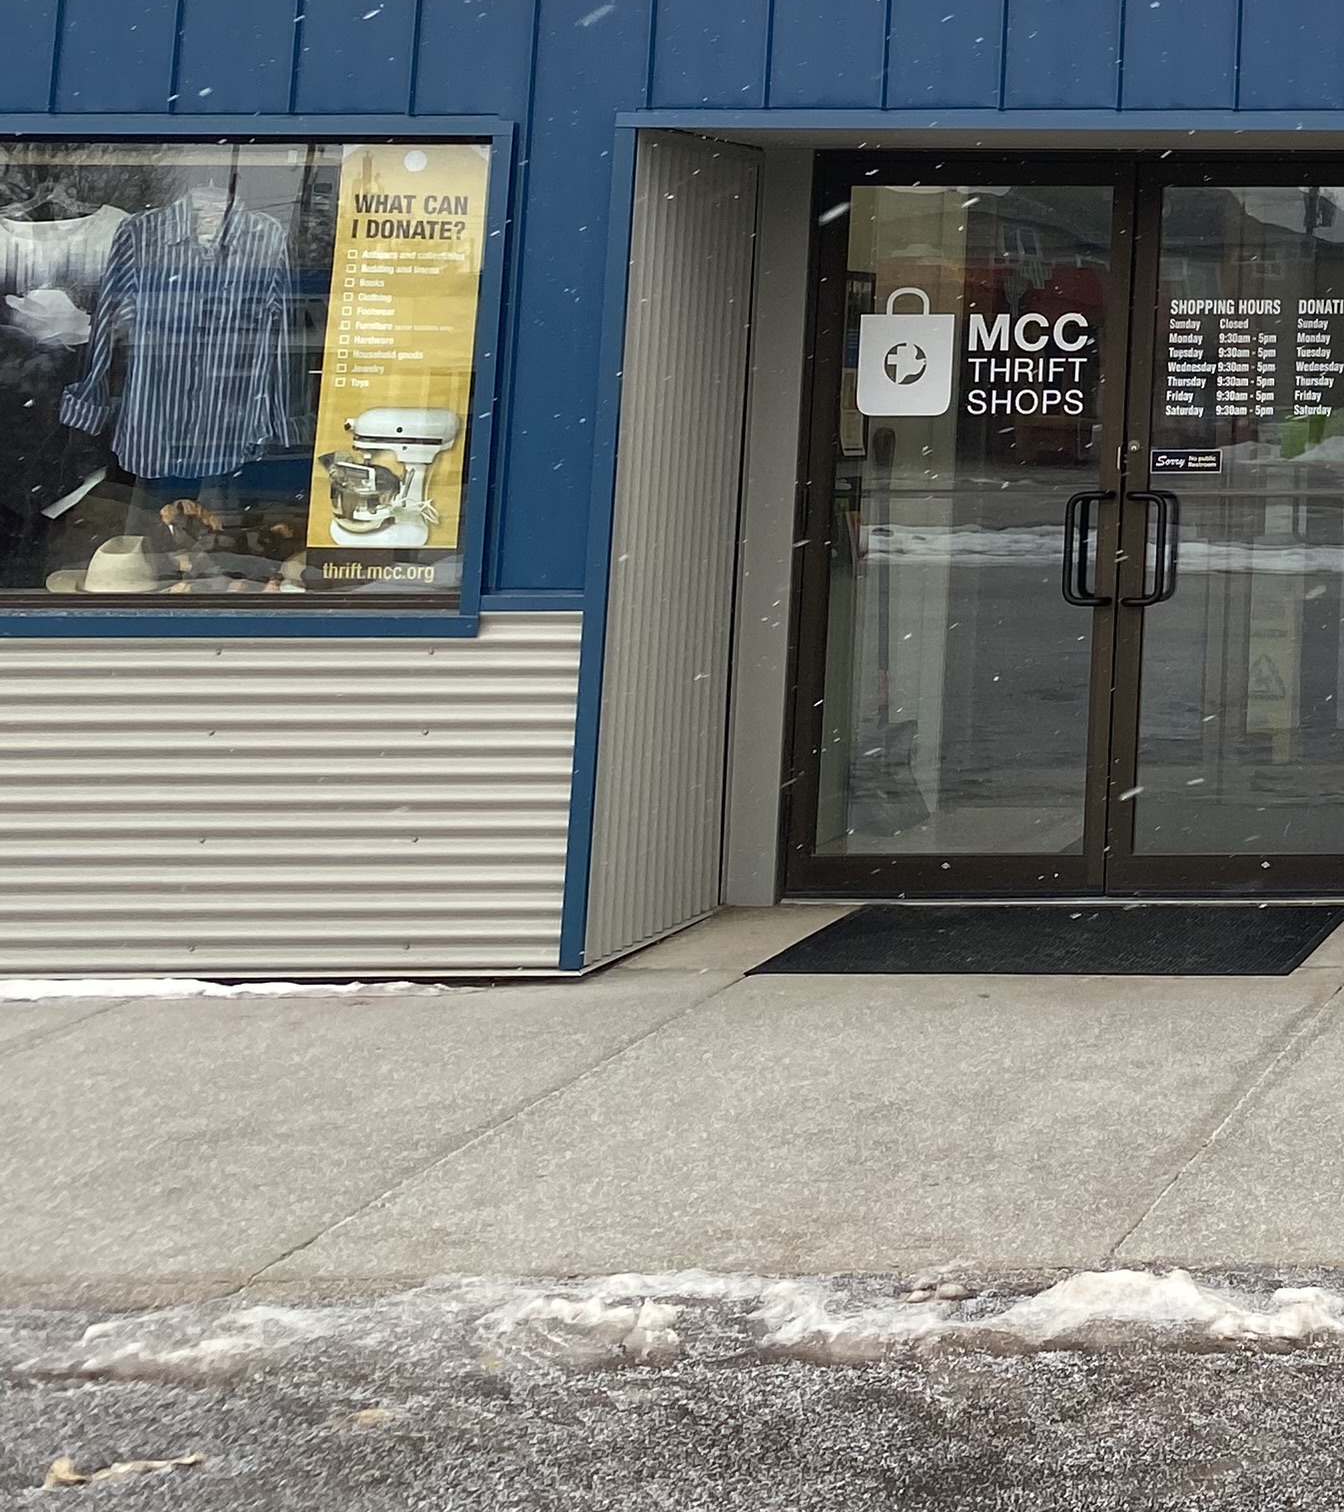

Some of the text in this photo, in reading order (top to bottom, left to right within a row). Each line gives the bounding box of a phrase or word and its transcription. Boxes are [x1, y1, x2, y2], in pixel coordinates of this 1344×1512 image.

[355, 194, 469, 215] WHAT CAN
[351, 219, 466, 240] I DONATE?
[1170, 299, 1281, 315] SHOPPING HOURS
[1170, 319, 1248, 331] Sunday Closed
[1297, 318, 1329, 330] Sunday
[968, 313, 1089, 352] MCC
[1169, 333, 1203, 345] Monday
[1219, 333, 1250, 343] 9:30am
[1258, 333, 1276, 345] 5pm
[1297, 333, 1330, 345] Monday
[1169, 348, 1203, 359] Tuesday
[1218, 348, 1249, 357] 9:30am
[1258, 348, 1276, 359] 5pm
[1297, 347, 1331, 359] Tuesday
[968, 358, 1088, 383] THRIFT
[1168, 362, 1216, 374] Wednesday
[1218, 362, 1249, 372] 9:30am
[1257, 362, 1275, 374] 5pm
[1296, 362, 1344, 373] Wednesday
[1167, 376, 1206, 388] Thursday
[1217, 376, 1248, 386] 9:30am
[1256, 376, 1274, 388] 5pm
[1296, 376, 1334, 388] Thursday
[967, 389, 1084, 415] SHOPS
[1166, 391, 1193, 403] Friday
[1216, 391, 1248, 400] 9:30am
[1256, 391, 1274, 402] 5pm
[1295, 391, 1321, 402] Friday
[1166, 405, 1204, 417] Saturday
[1216, 405, 1247, 415] 9:30am
[1255, 405, 1273, 417] 5pm
[1294, 405, 1332, 417] Saturday
[1156, 455, 1186, 468] Sorry
[323, 562, 435, 583] thrift.mcc.org
